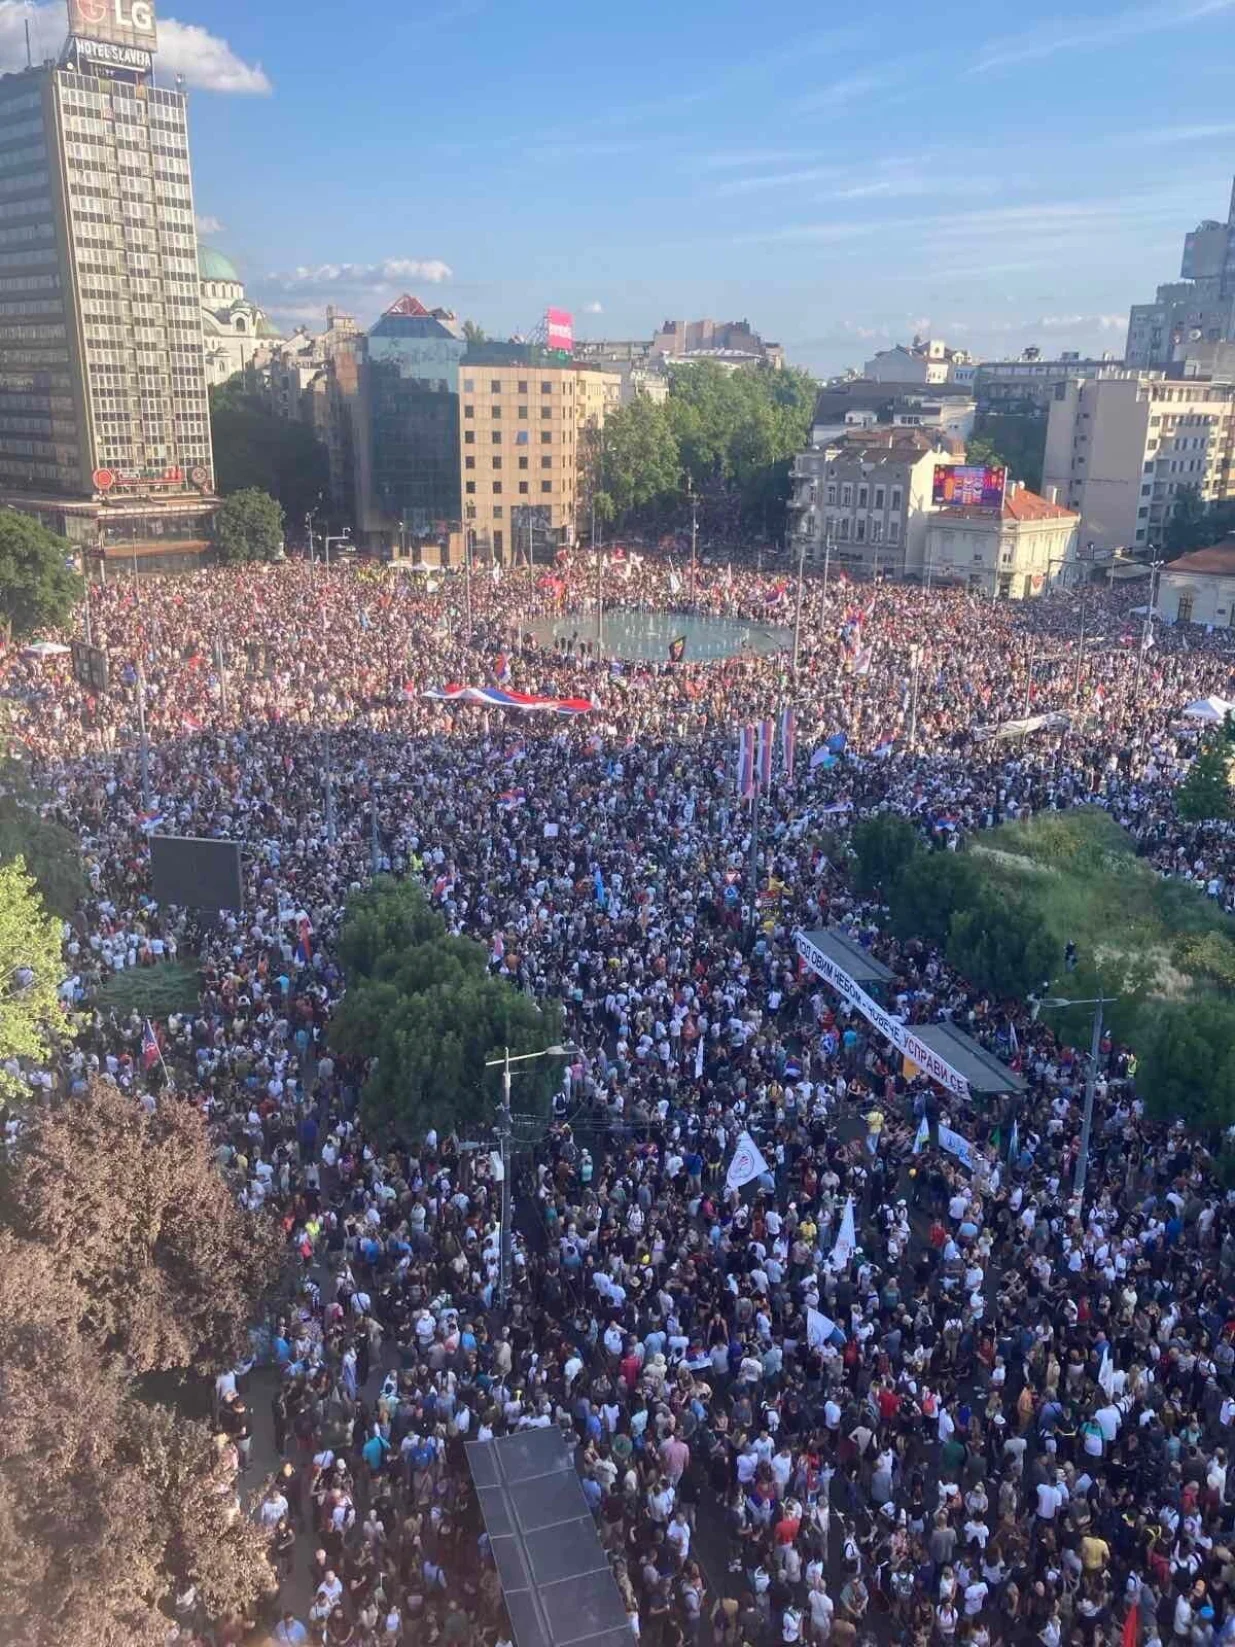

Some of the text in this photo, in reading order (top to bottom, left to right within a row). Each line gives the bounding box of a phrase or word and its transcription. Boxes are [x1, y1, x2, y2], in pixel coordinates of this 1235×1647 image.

[115, 0, 152, 30] LG
[76, 39, 151, 66] HOTEL SLAVIJA
[811, 951, 834, 978] ОВИМ
[834, 969, 862, 1004] НЕБОМ
[903, 1033, 948, 1080] УСПРАВИ
